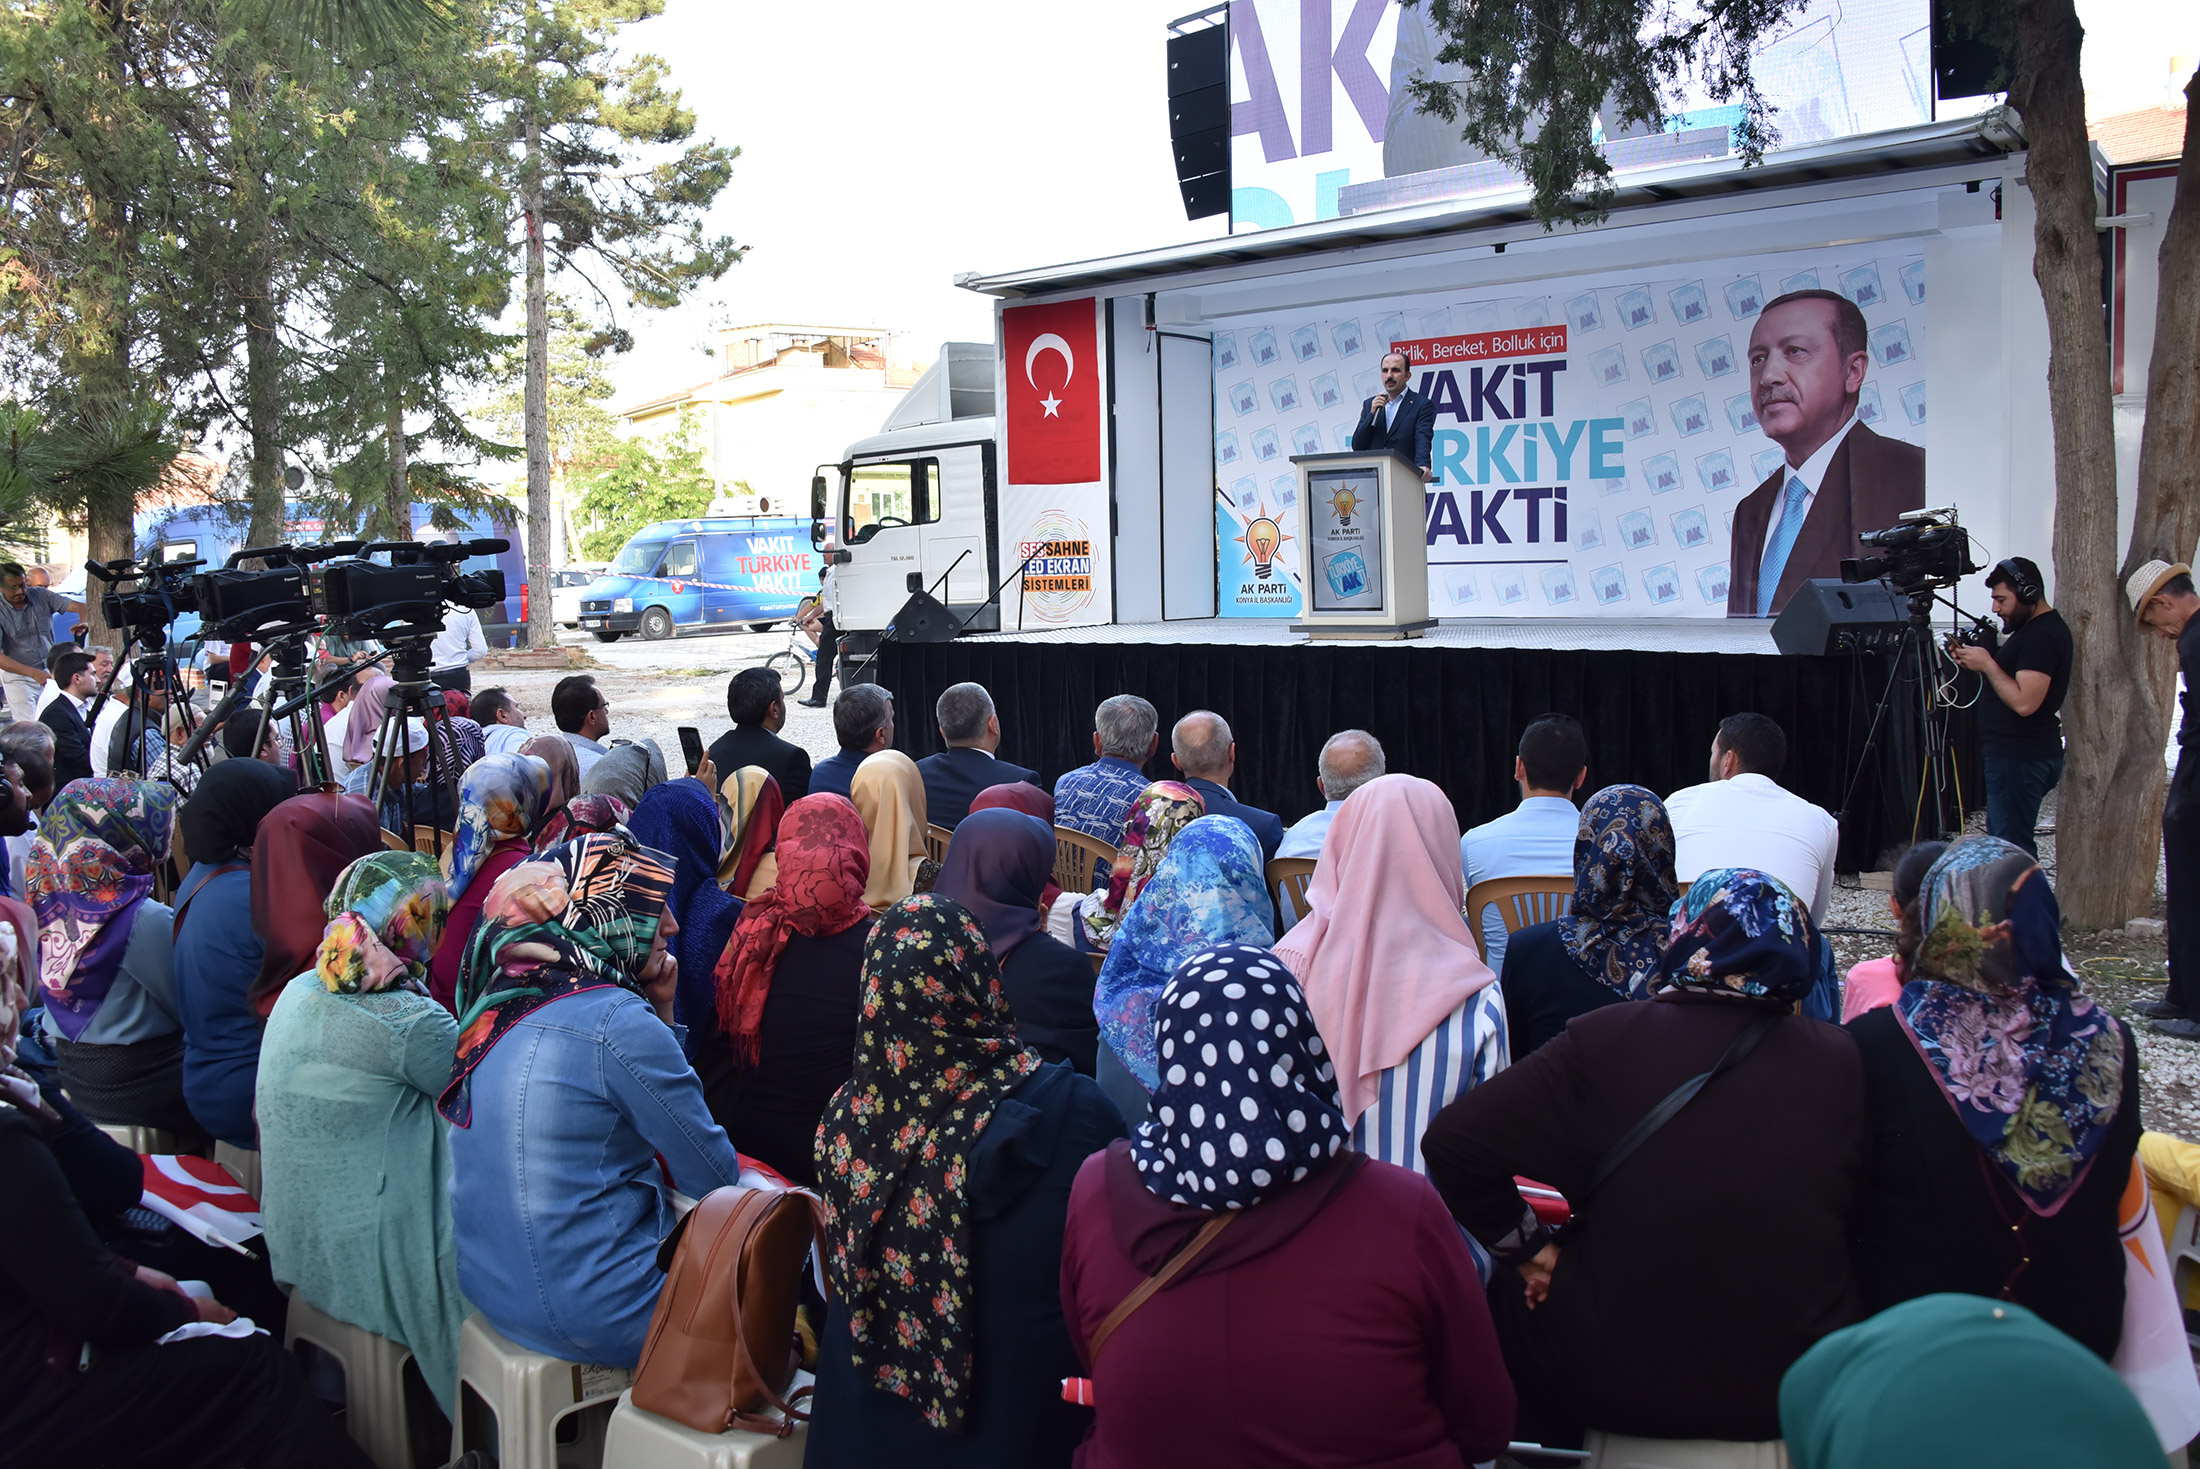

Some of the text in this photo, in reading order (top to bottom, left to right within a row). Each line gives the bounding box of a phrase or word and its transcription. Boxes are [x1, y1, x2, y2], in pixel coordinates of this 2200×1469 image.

[1433, 340, 1488, 358] Bereket,
[1493, 334, 1536, 352] Bolluk
[1540, 332, 1564, 351] için
[1432, 417, 1625, 487] RKİYE
[1046, 541, 1089, 556] SAHNE
[736, 554, 811, 575] TÜRKİYE
[1022, 558, 1090, 573] LED EKRAN
[1024, 577, 1089, 590] SİSTEMLERİ
[1241, 584, 1254, 594] AK
